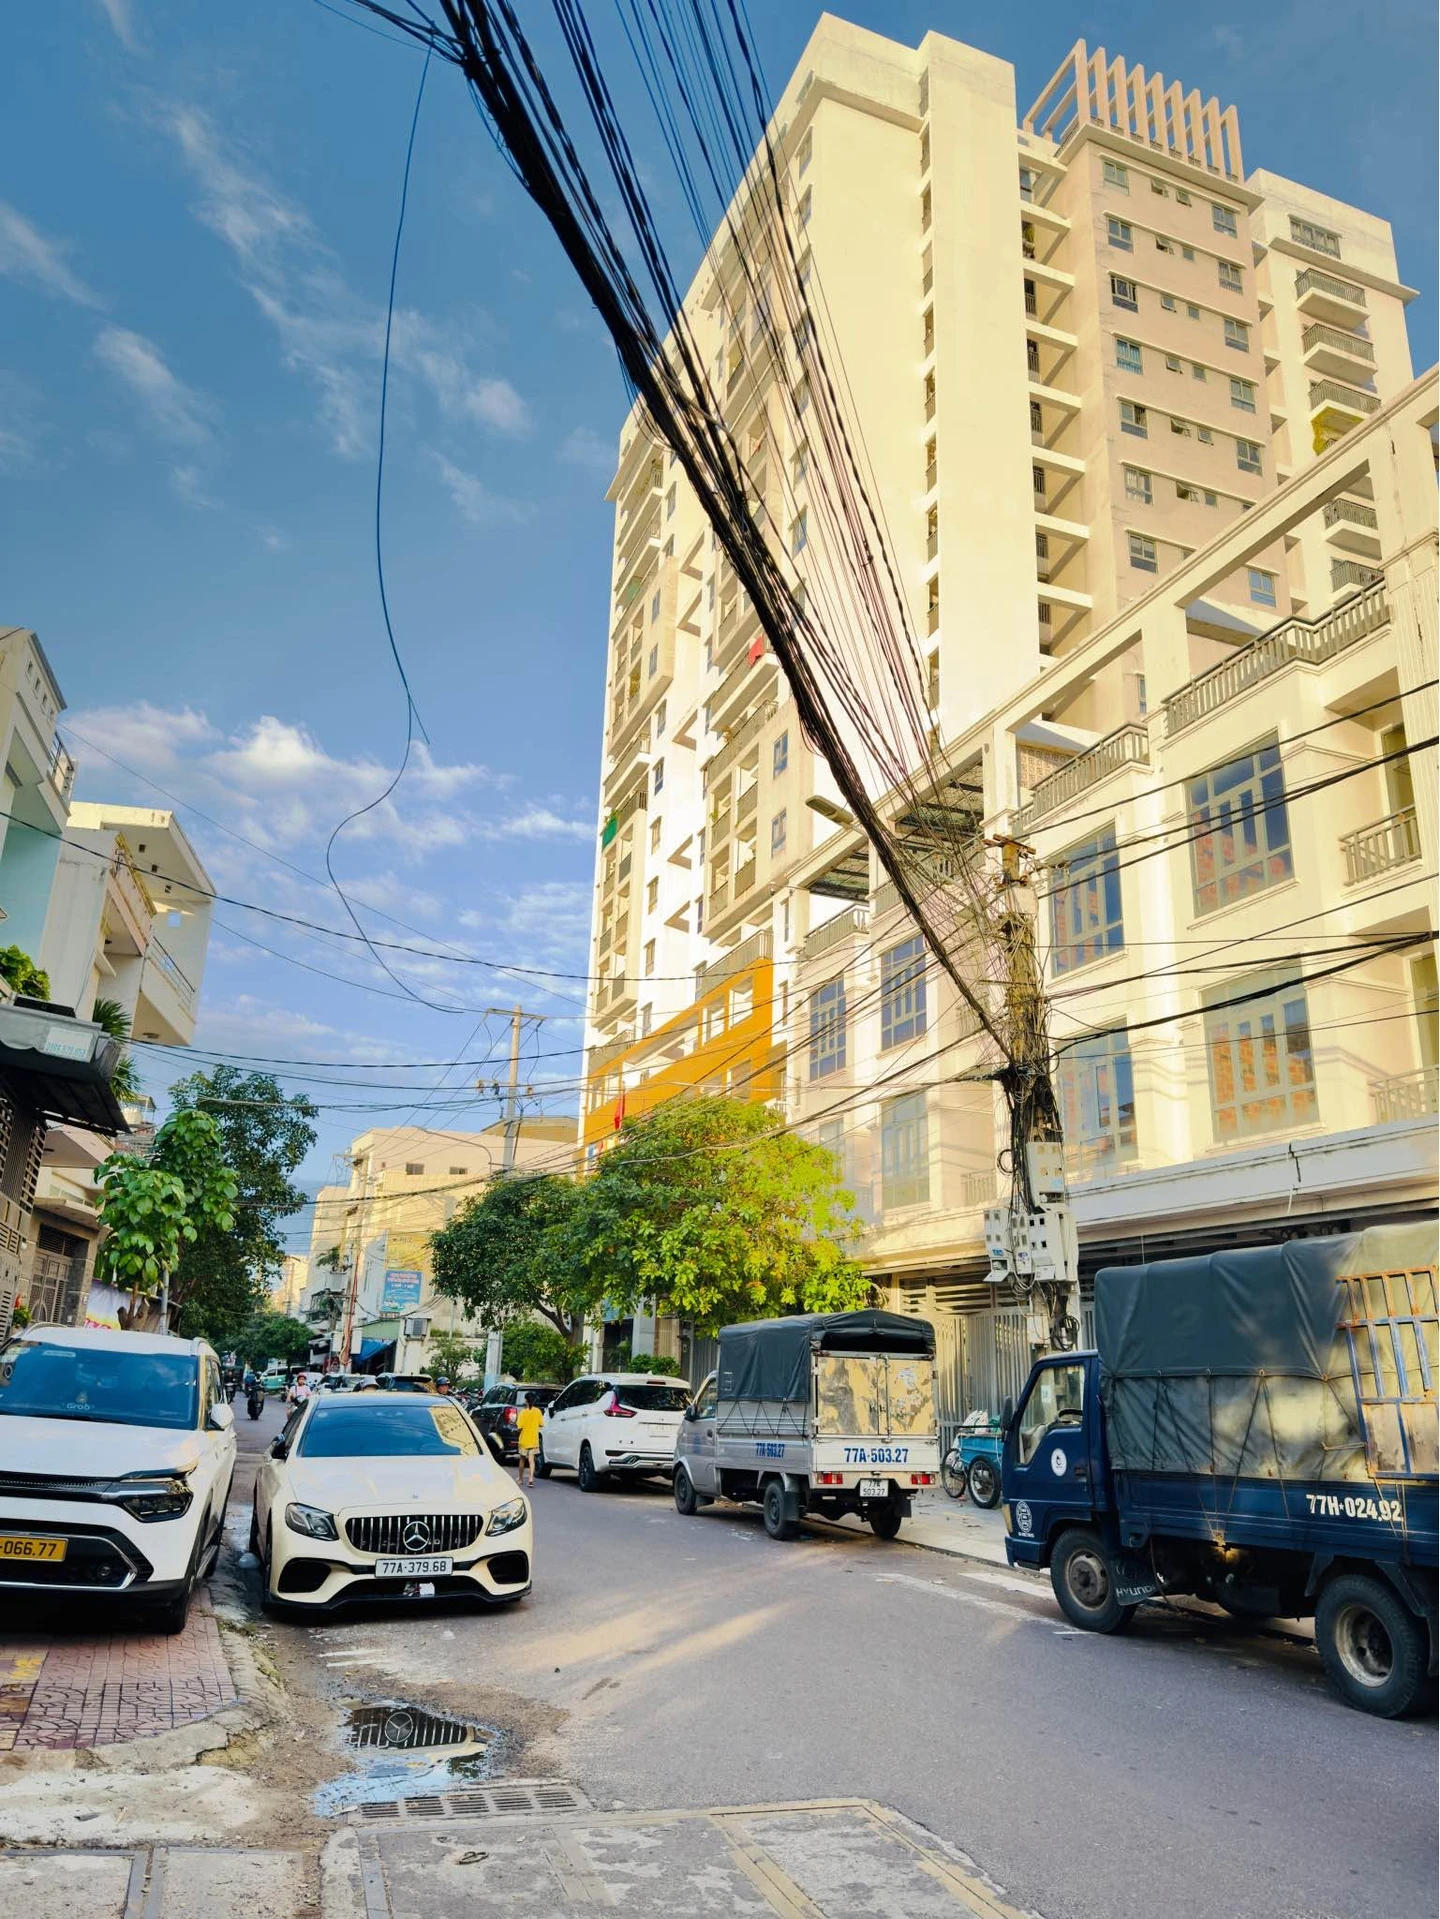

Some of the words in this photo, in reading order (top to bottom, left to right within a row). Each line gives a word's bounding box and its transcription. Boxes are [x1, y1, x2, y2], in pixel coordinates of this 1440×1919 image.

[756, 1442, 785, 1459] 77A-503.27
[844, 1448, 908, 1463] 77A-503.27
[382, 1561, 447, 1574] 77A-379.68
